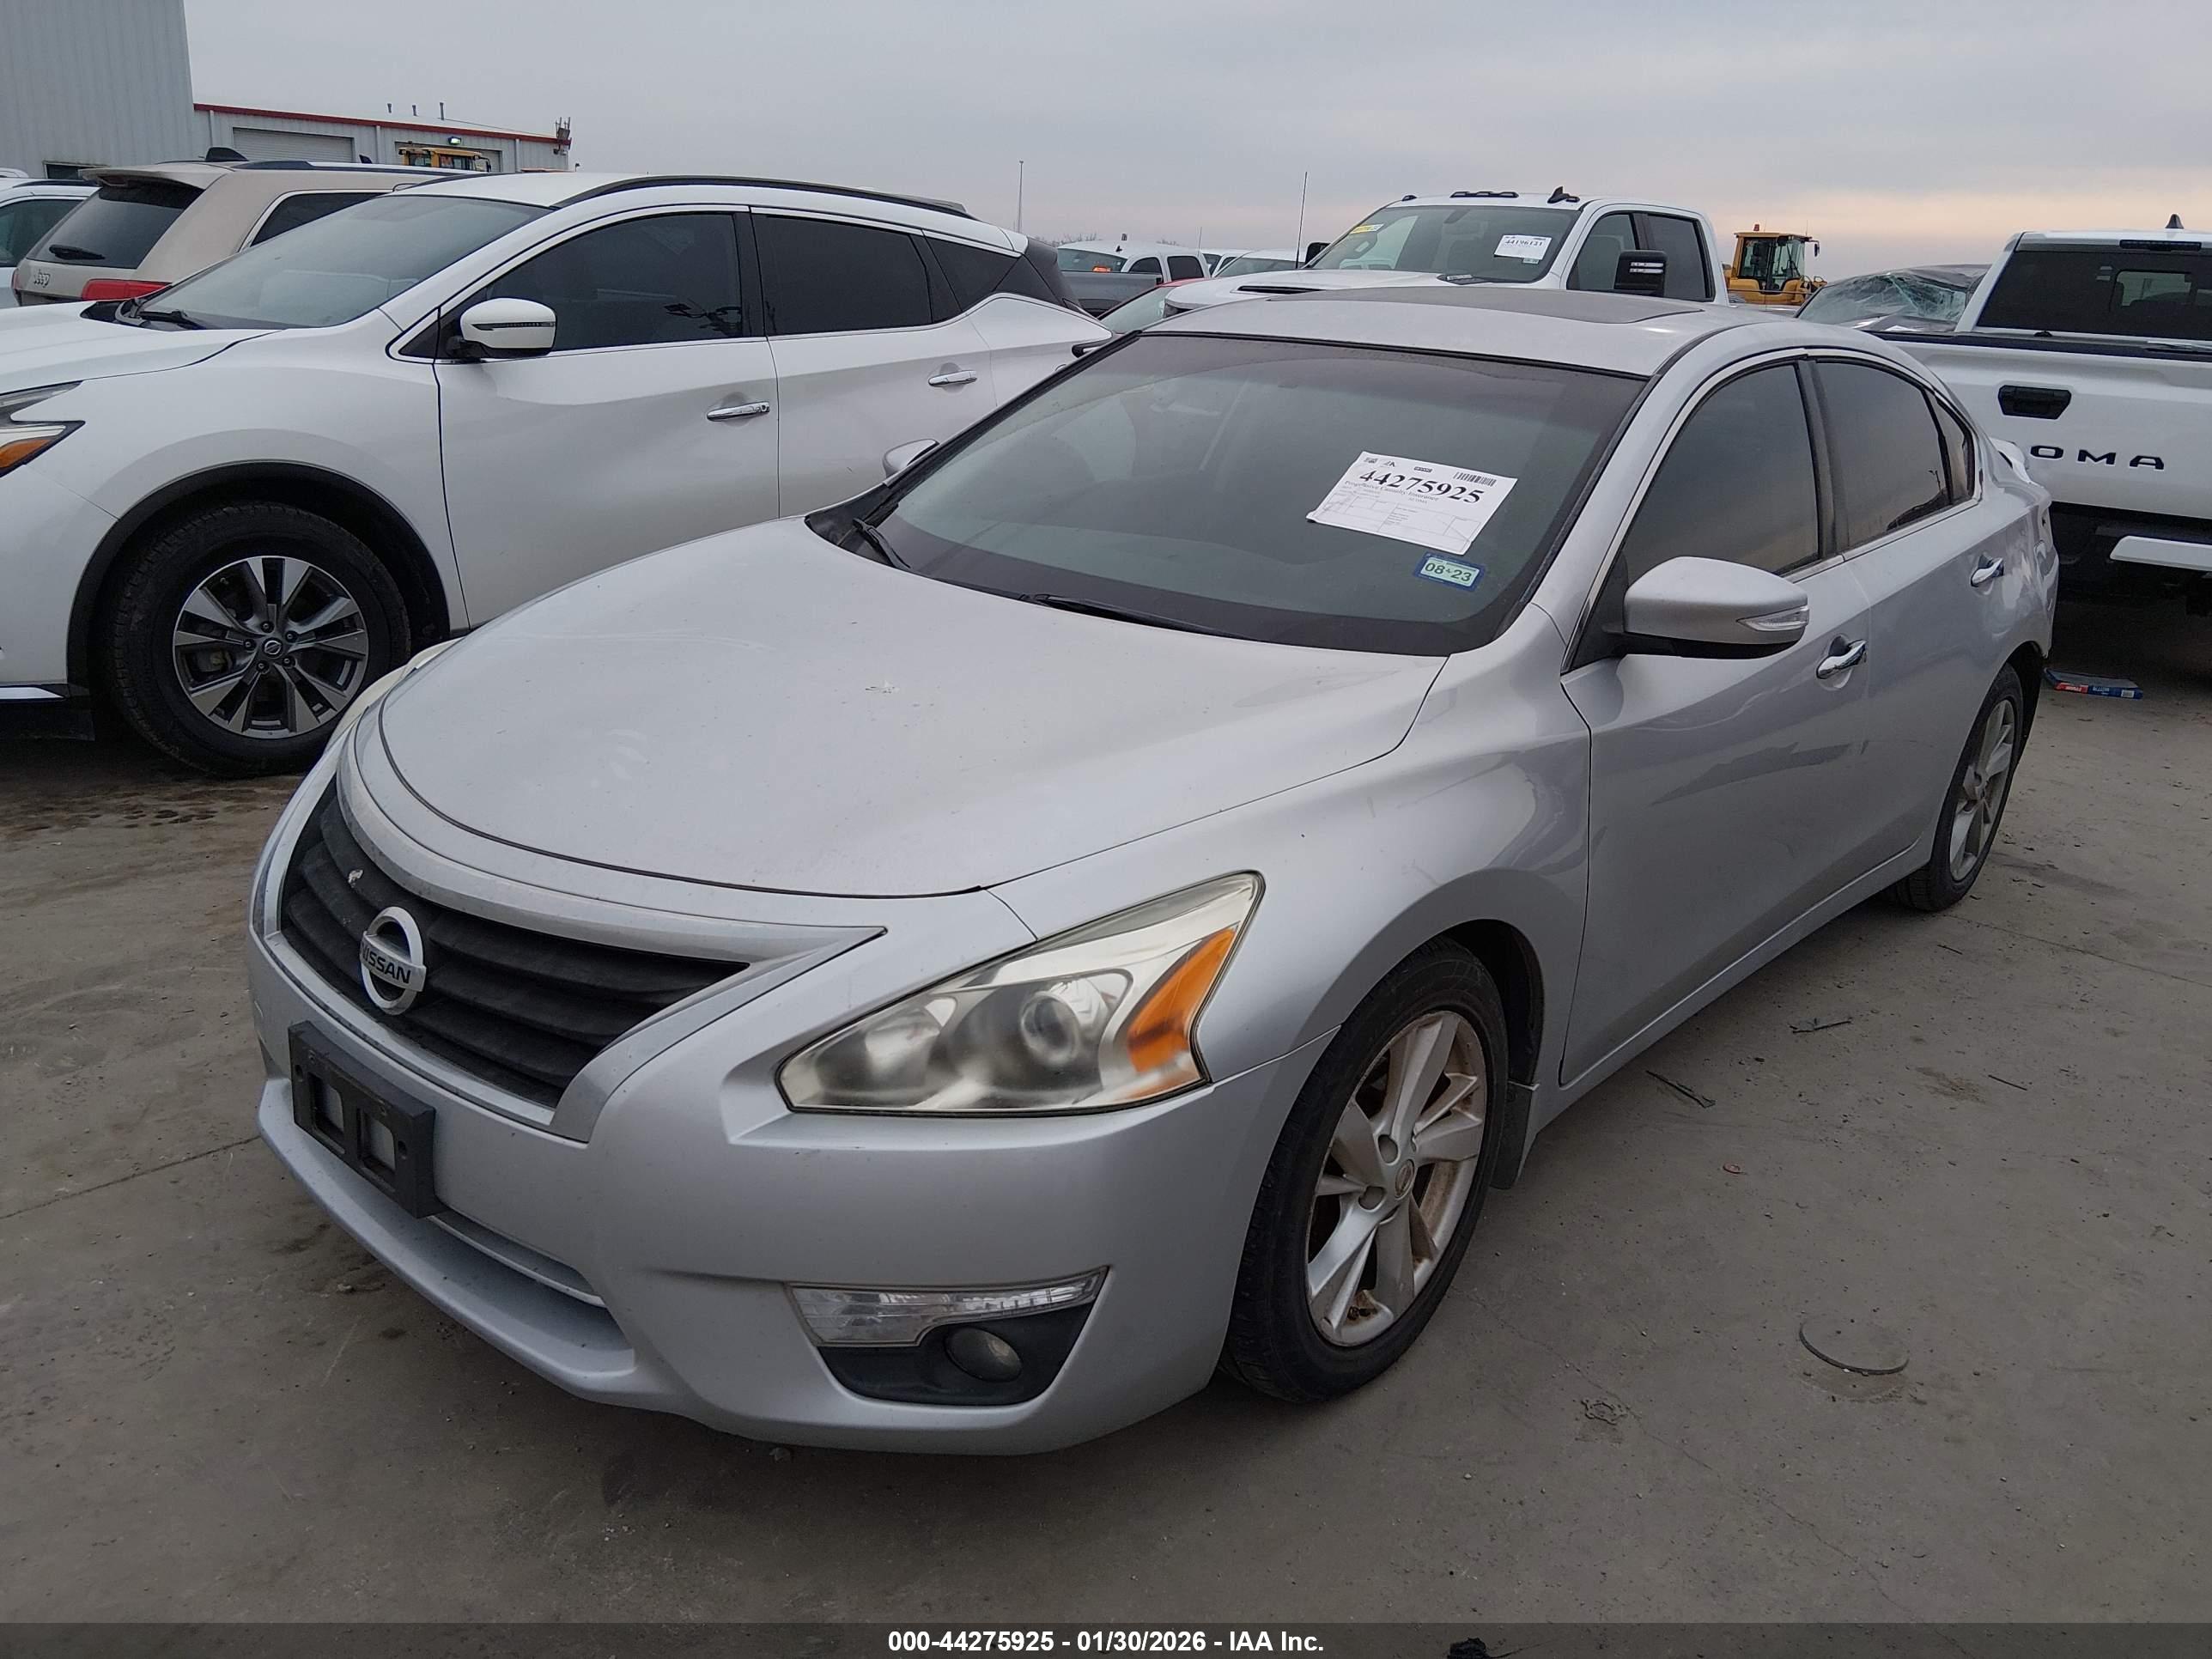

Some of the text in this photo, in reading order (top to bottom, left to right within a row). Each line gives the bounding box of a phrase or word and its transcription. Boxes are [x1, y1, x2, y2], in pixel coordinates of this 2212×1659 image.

[2030, 445, 2165, 471] OMA
[1359, 470, 1485, 504] 44275925
[1425, 562, 1472, 581] 08 23
[362, 942, 411, 984] NISSAN
